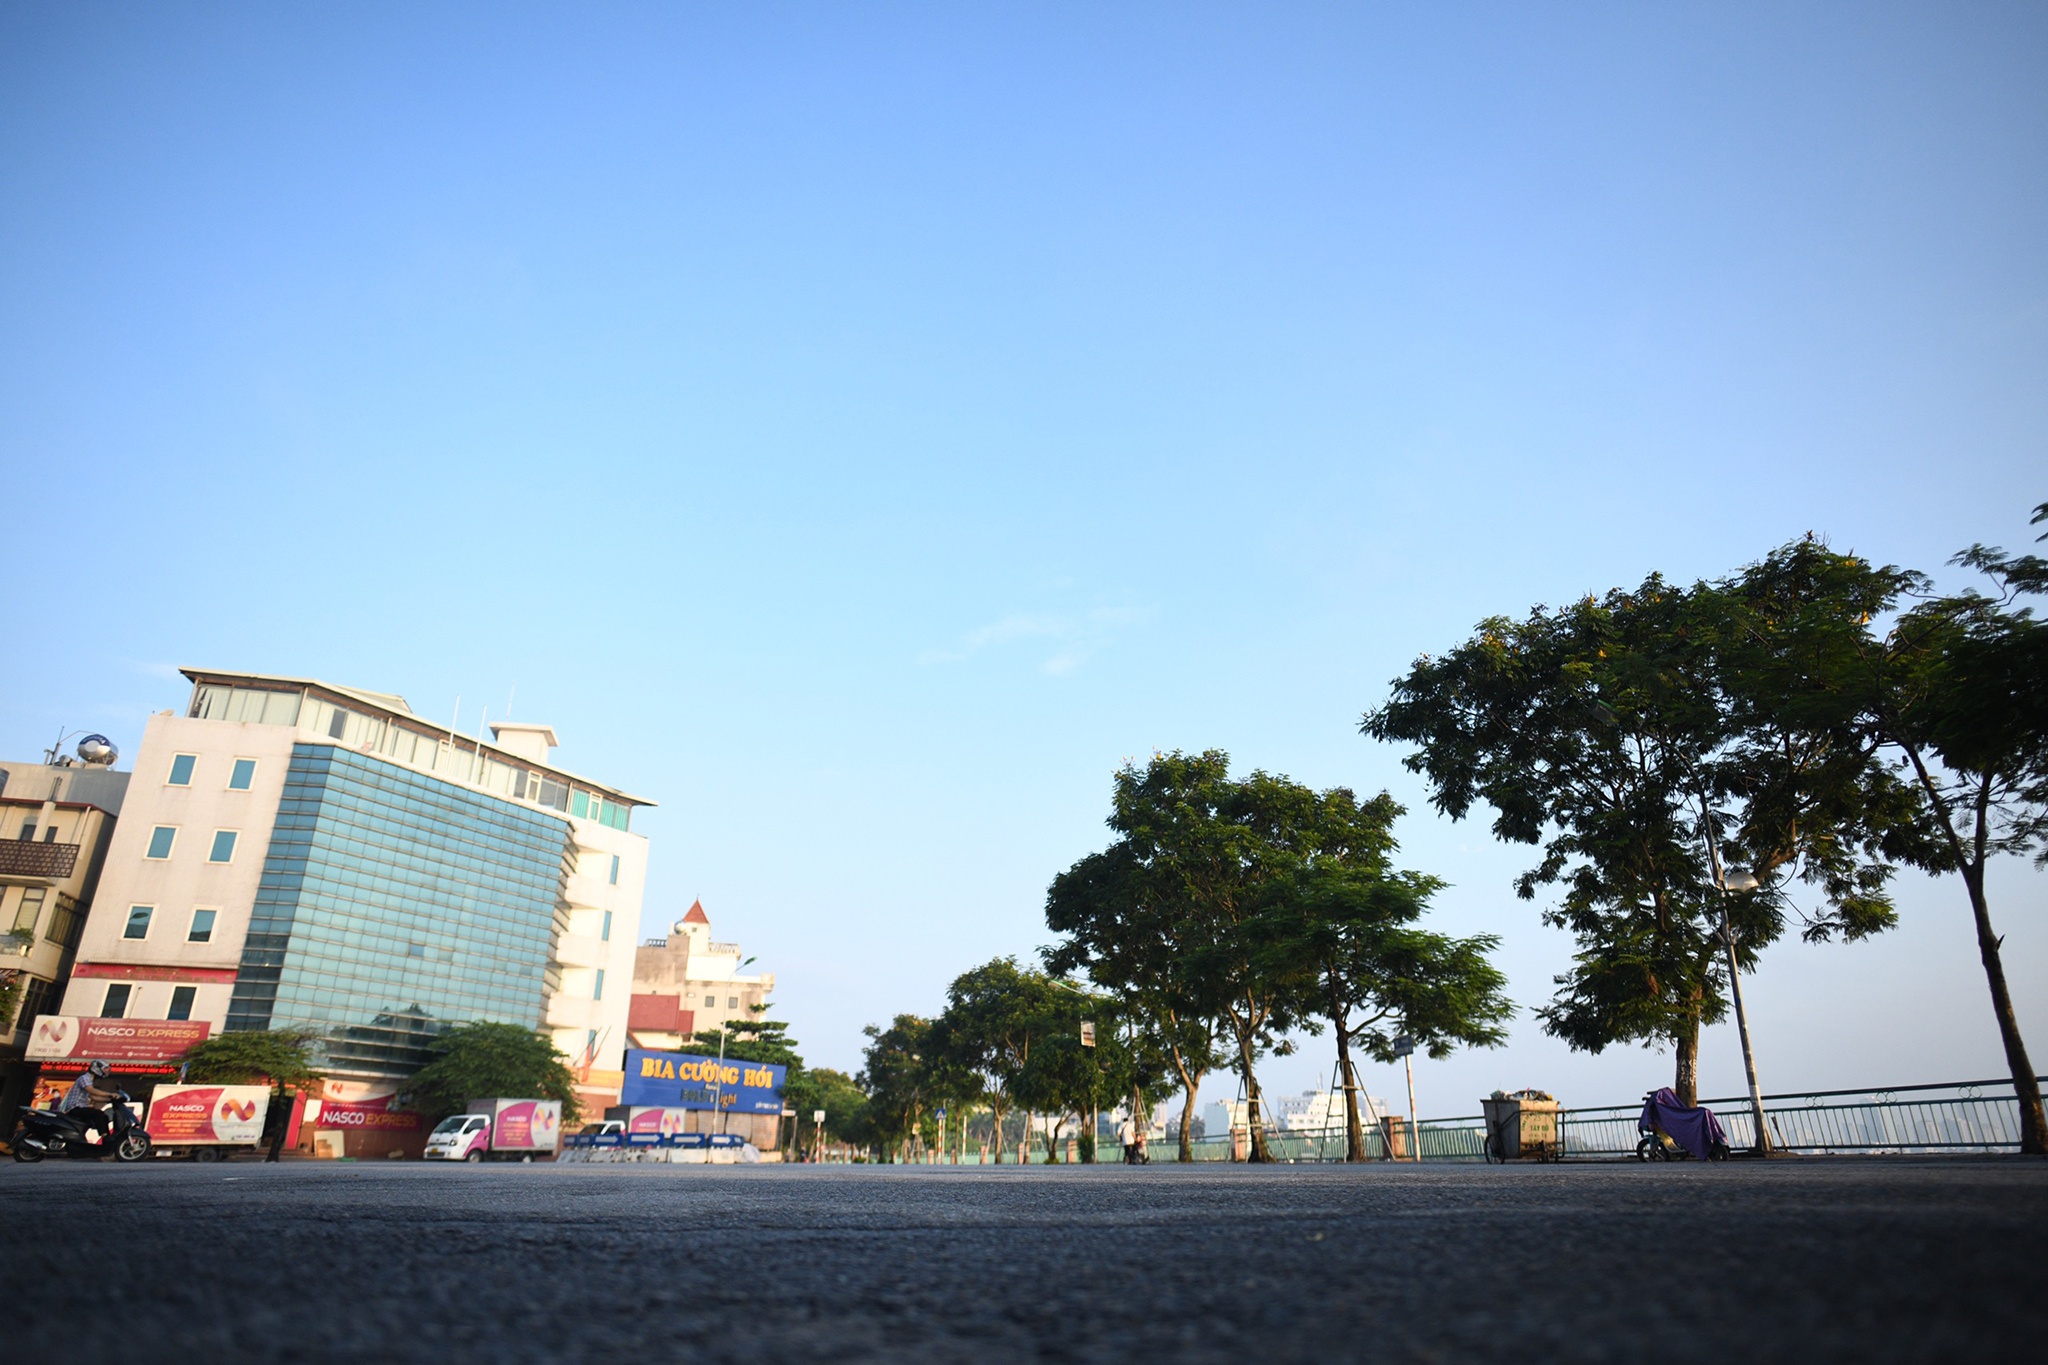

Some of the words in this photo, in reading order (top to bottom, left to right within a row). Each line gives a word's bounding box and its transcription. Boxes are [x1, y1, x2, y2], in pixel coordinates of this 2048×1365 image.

[87, 1027, 135, 1037] NASCO
[136, 1028, 200, 1039] EXPRESS
[640, 1057, 675, 1080] BIA
[679, 1058, 740, 1085] CƯỜNG
[743, 1065, 773, 1089] HÓI
[322, 1111, 365, 1125] NASCO
[365, 1113, 417, 1127] EXPRESS
